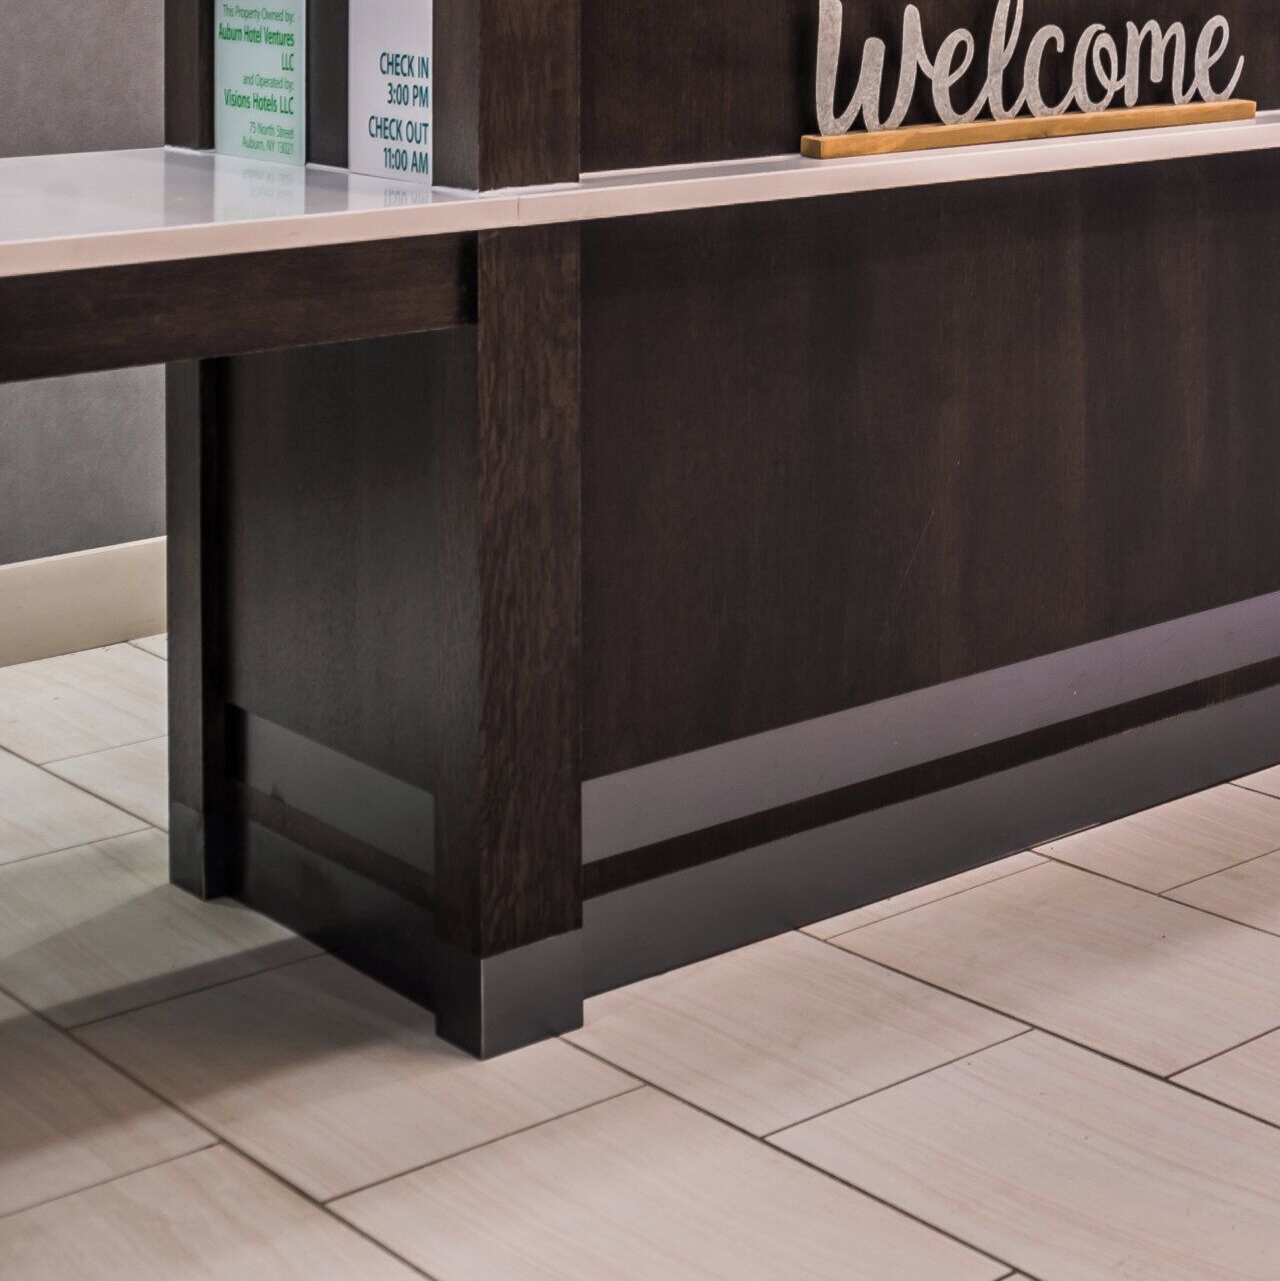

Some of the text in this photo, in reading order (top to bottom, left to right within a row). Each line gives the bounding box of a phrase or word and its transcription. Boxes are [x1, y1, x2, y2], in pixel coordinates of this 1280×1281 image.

[244, 25, 261, 43] Hotel
[264, 27, 294, 46] Ventures
[281, 53, 294, 71] LLC
[380, 52, 429, 79] CHECK IN
[224, 89, 294, 115] Visions Hotels LLC
[387, 83, 429, 108] 3:00 PM
[368, 115, 429, 145] CHECK OUT
[383, 147, 429, 175] 11:00 AM
